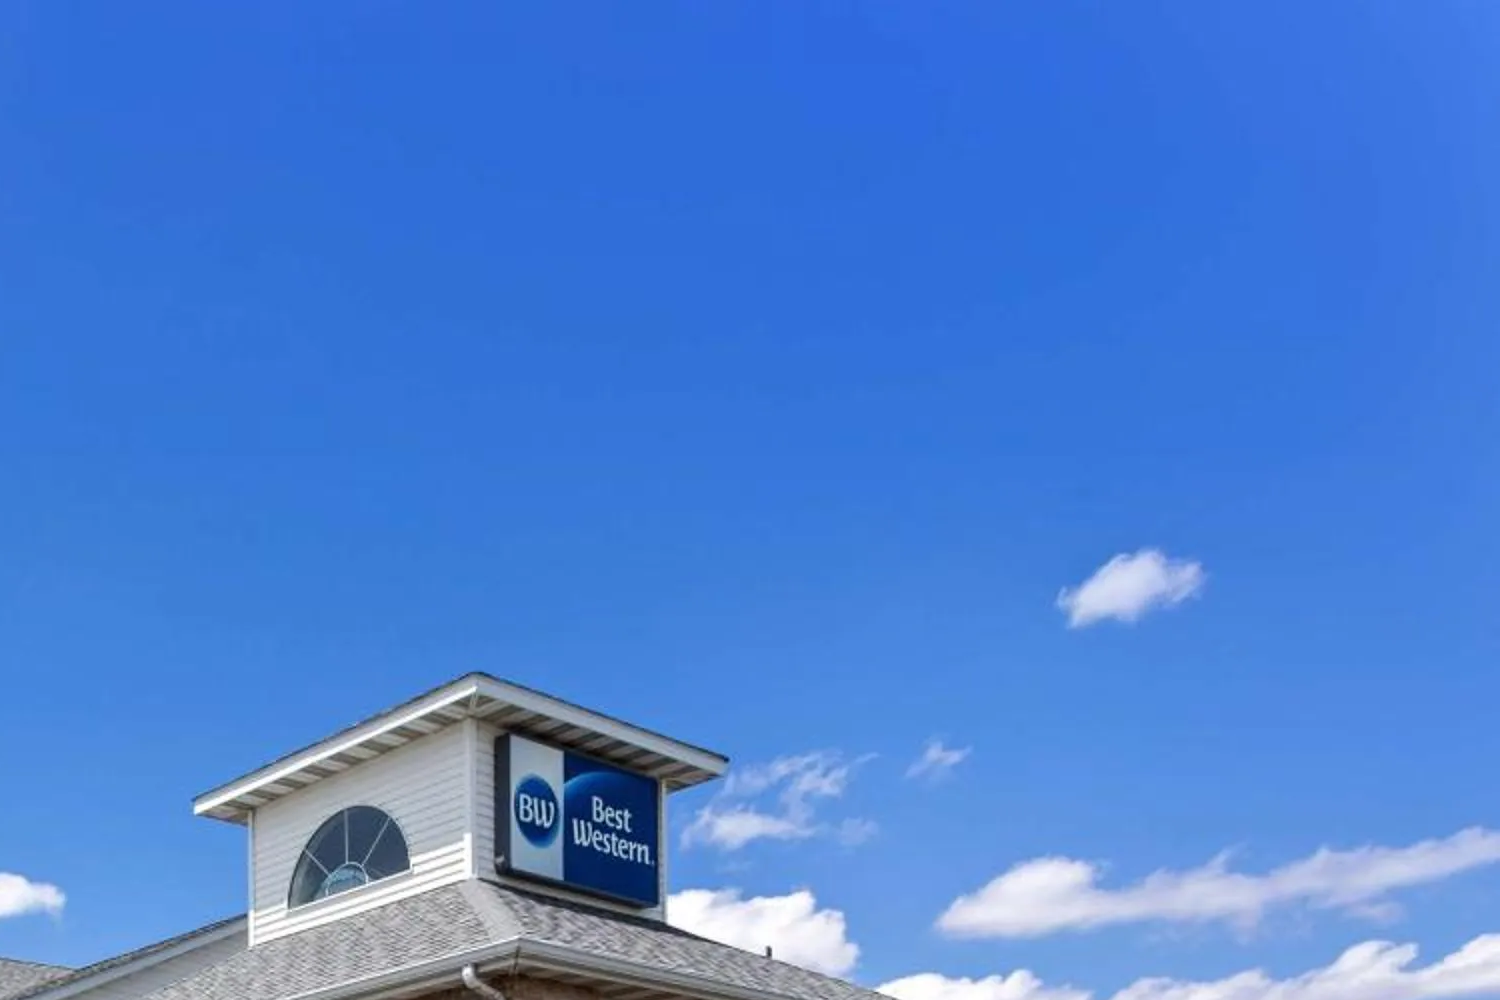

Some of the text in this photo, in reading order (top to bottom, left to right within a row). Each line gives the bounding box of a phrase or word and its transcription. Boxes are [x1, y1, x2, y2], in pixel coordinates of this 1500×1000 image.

[519, 793, 554, 828] BW
[592, 796, 632, 832] Best
[572, 818, 650, 865] Western
